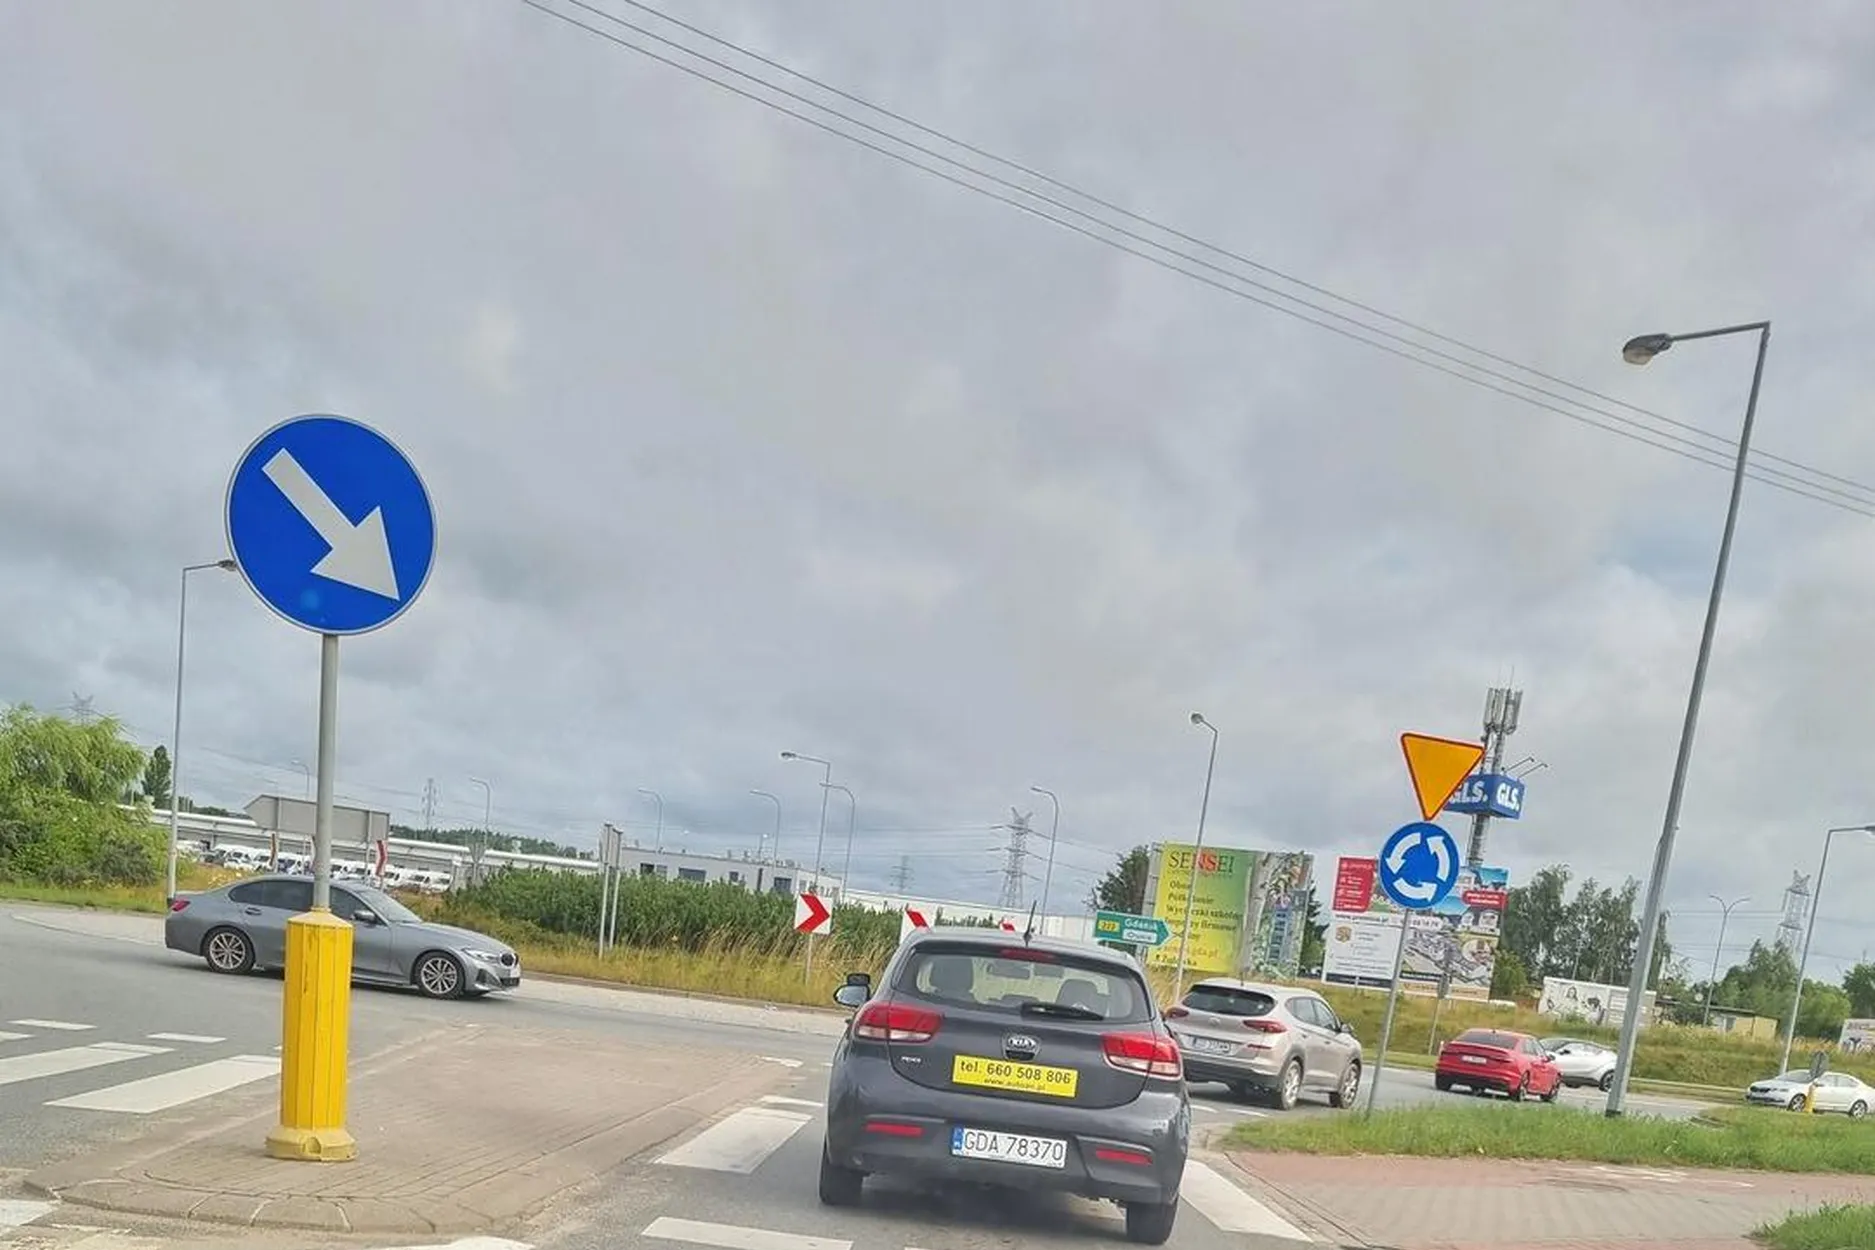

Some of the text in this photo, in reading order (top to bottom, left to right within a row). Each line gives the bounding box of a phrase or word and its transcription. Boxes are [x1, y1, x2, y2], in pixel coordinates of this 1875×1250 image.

[961, 1061, 1071, 1084] tel. 660 508 806
[965, 1131, 1064, 1161] GDA 78370
